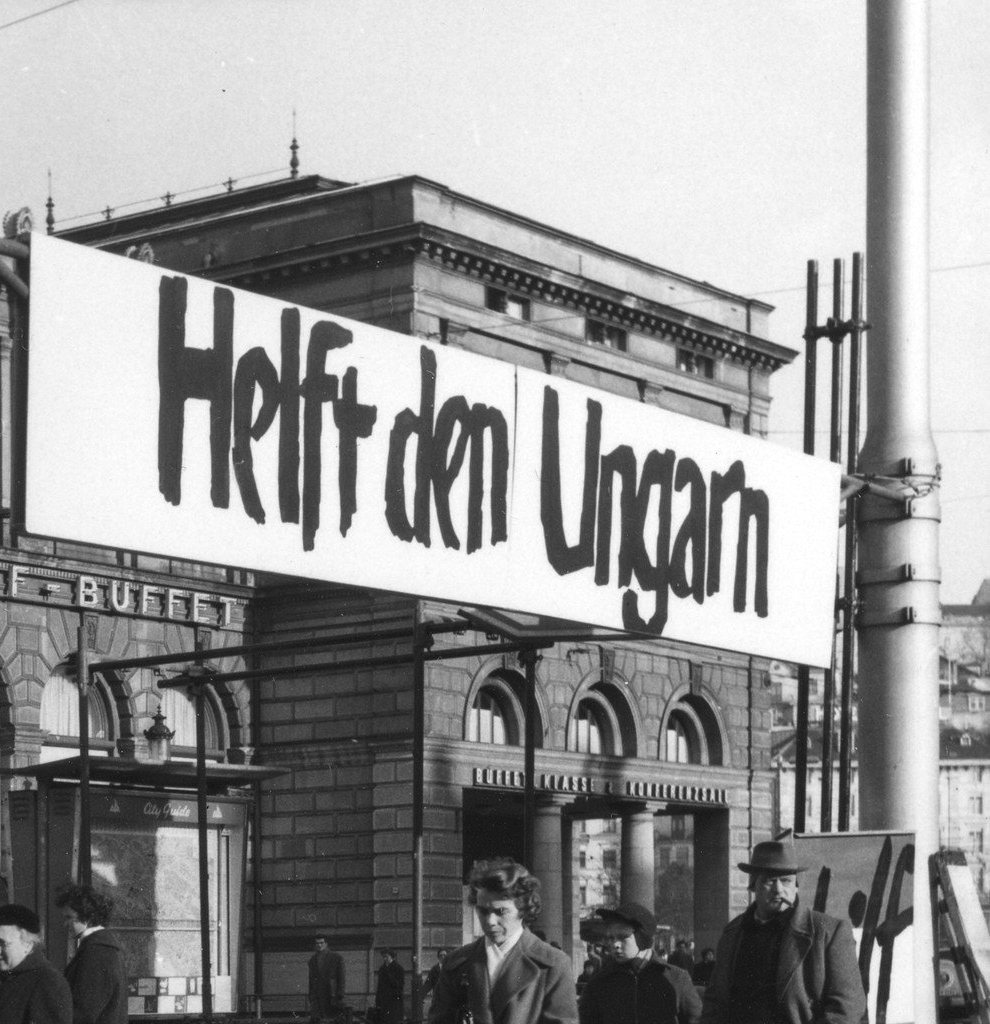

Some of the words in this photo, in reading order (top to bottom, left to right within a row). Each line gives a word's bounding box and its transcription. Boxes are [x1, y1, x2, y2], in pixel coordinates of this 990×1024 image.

[157, 275, 378, 552] Helft
[384, 344, 509, 555] den
[540, 384, 769, 636] Ungarn
[476, 767, 526, 788] BUFFE
[143, 801, 162, 818] City
[163, 802, 191, 819] Guide
